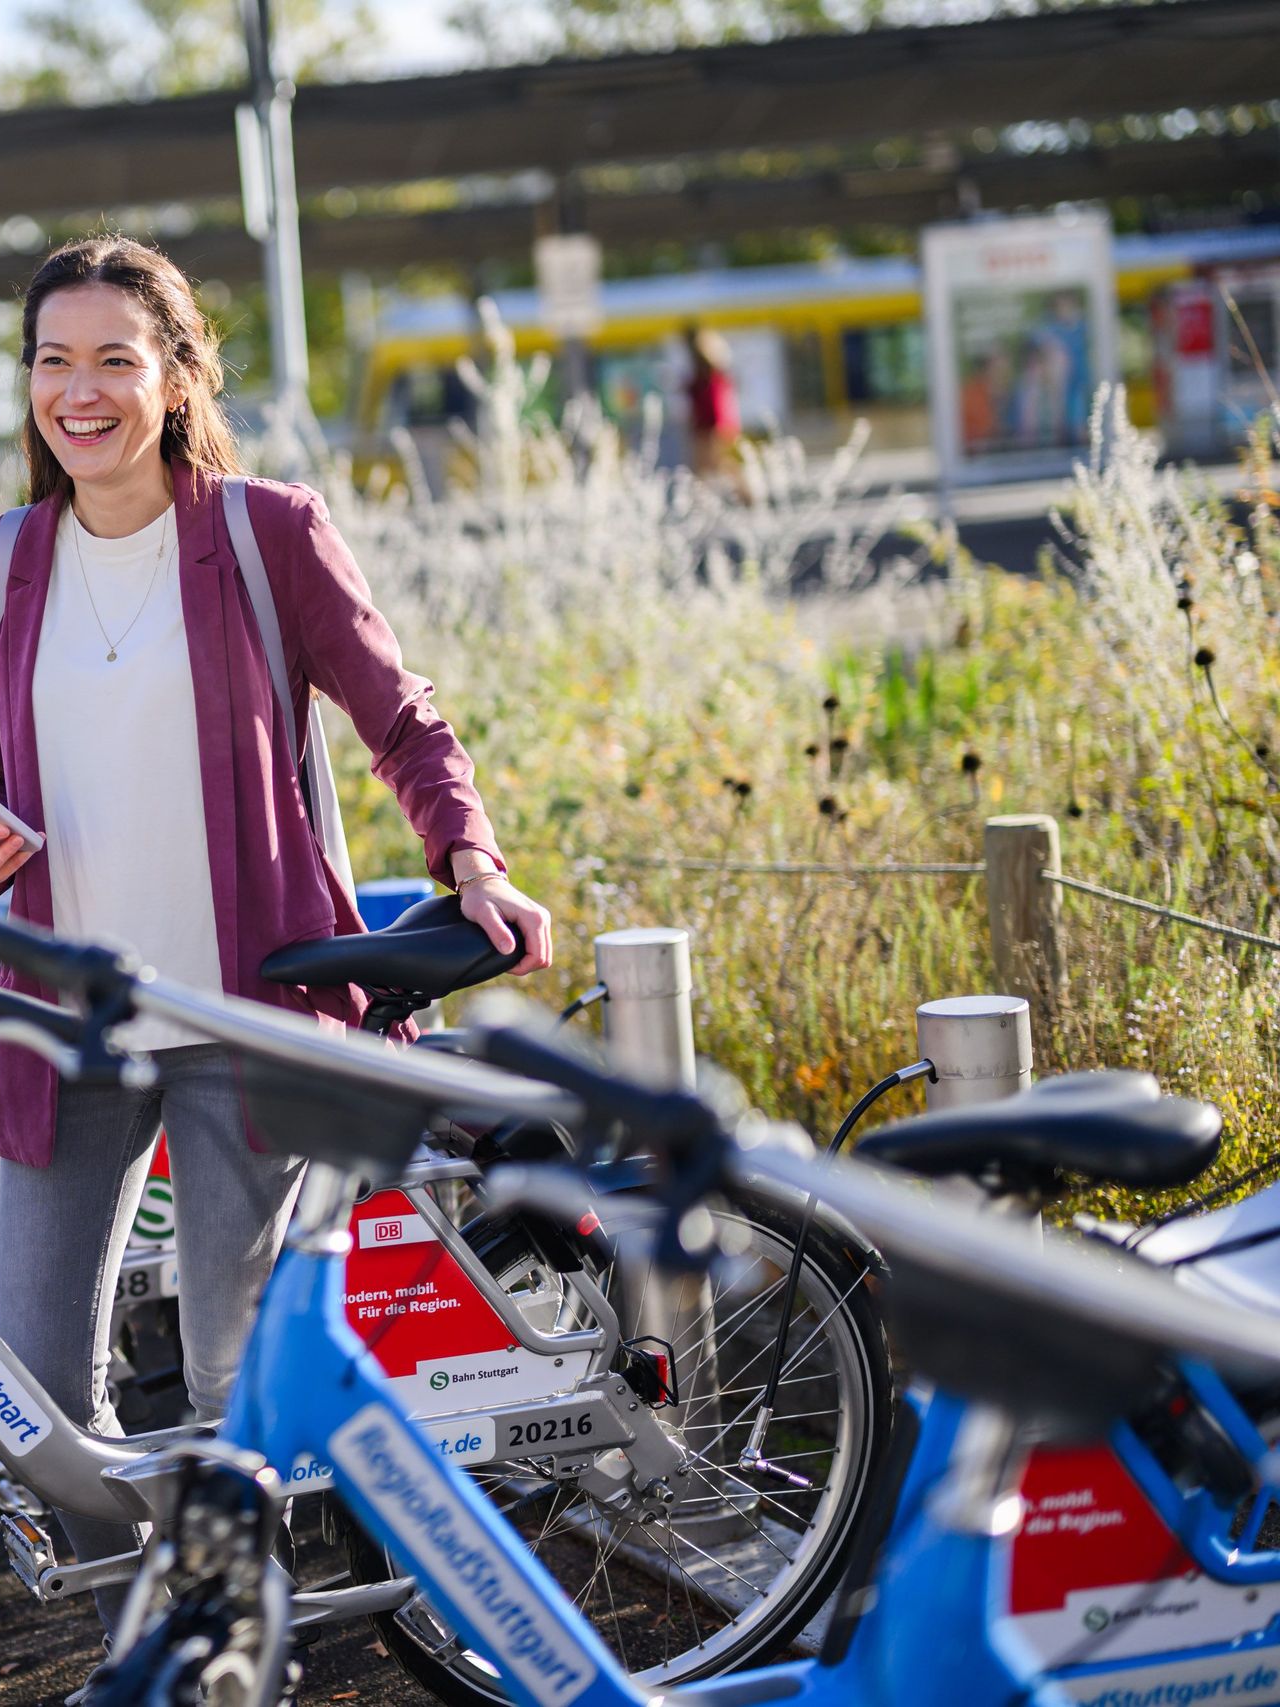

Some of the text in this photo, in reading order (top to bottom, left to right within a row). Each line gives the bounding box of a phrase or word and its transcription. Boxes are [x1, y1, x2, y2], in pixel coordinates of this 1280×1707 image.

[377, 1223, 400, 1240] DB
[395, 1282, 439, 1298] mobil.
[358, 1297, 461, 1319] Für die Region.
[452, 1373, 476, 1384] Bahn
[477, 1365, 519, 1380] Stuttgart
[508, 1413, 593, 1447] 20216
[354, 1421, 582, 1693] RegioRadStuttgart
